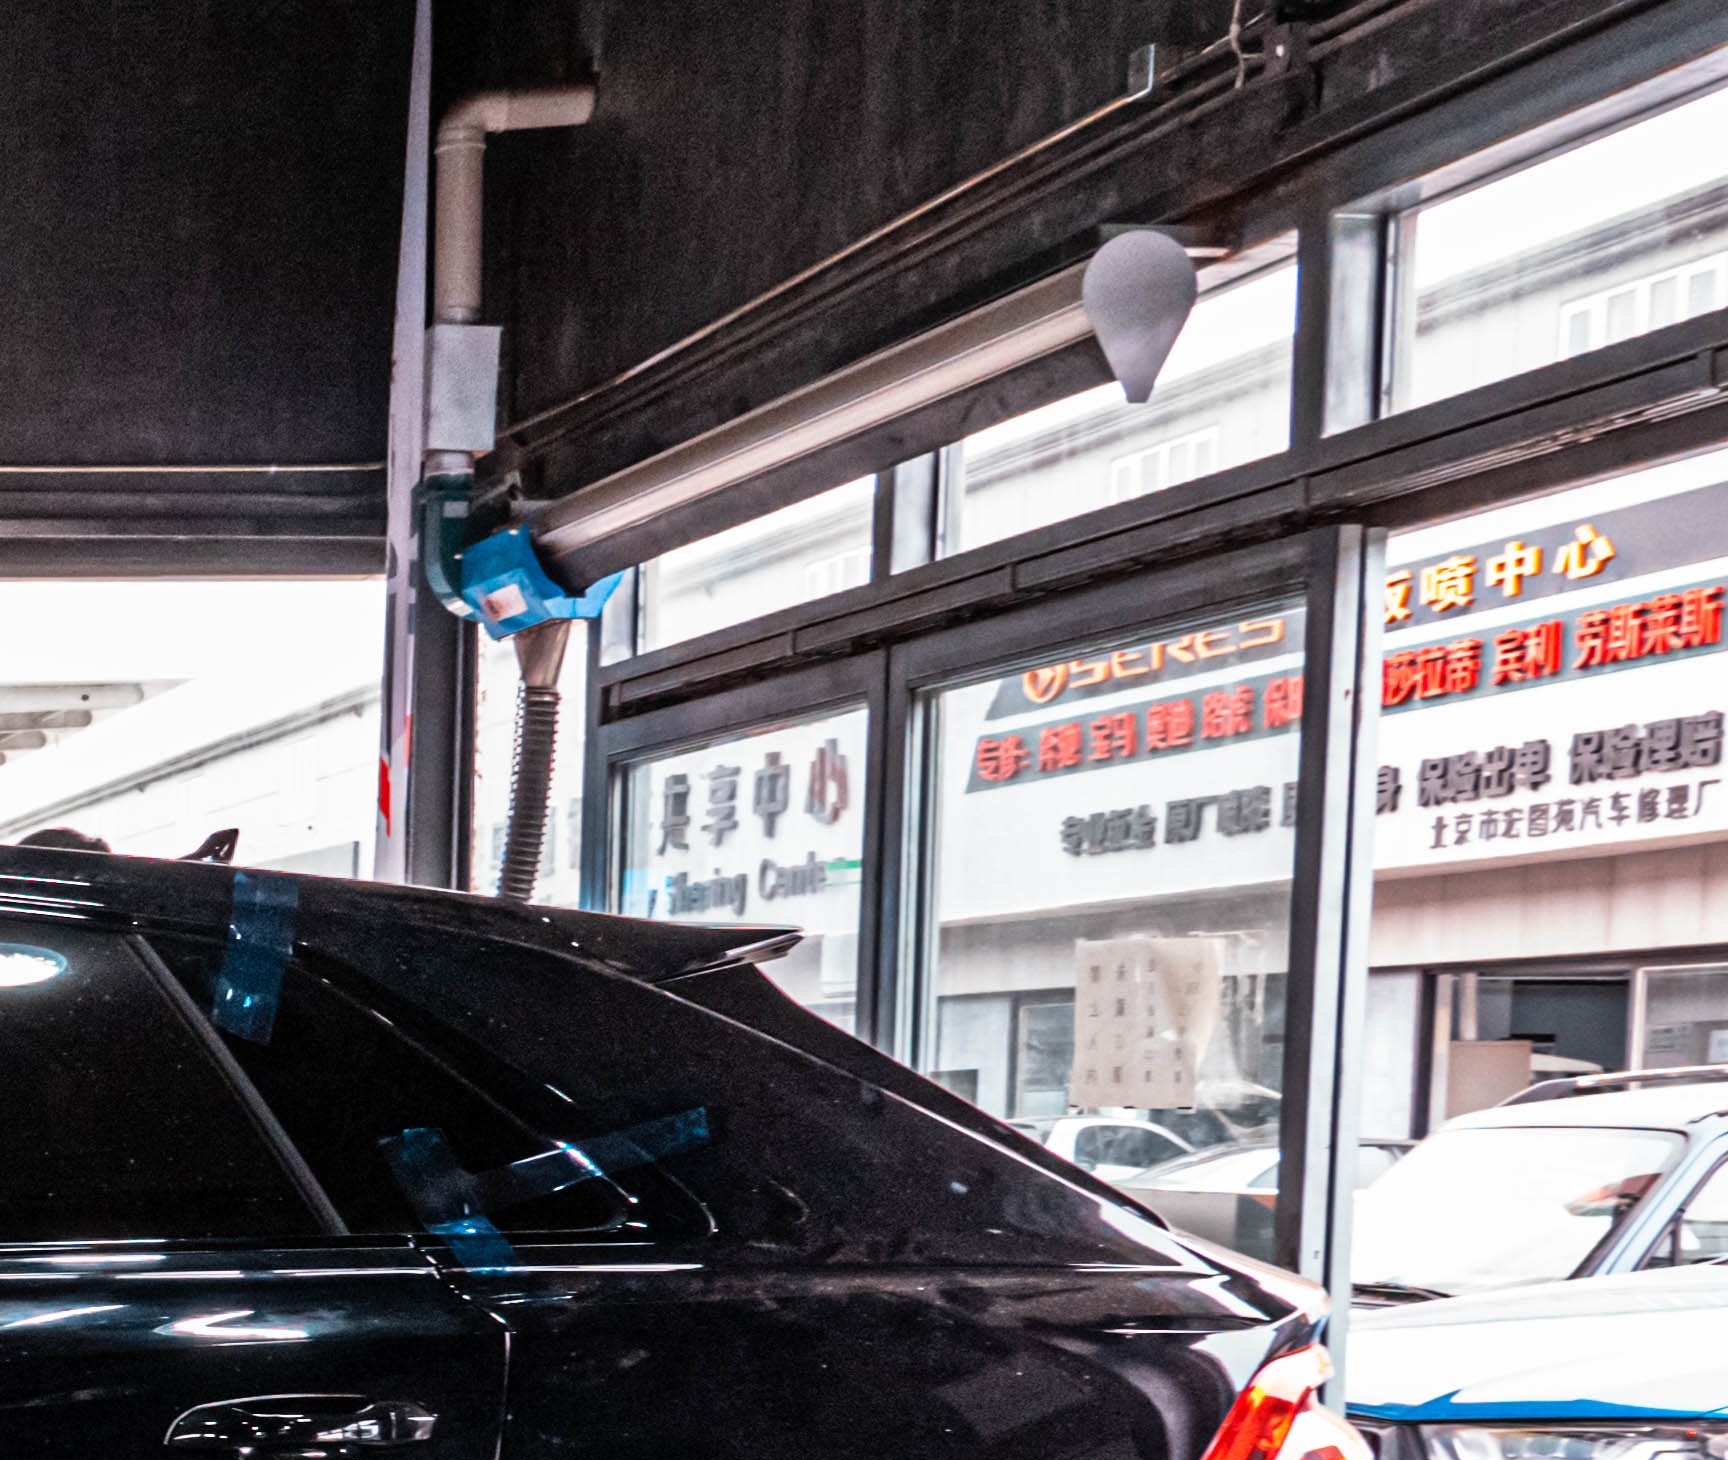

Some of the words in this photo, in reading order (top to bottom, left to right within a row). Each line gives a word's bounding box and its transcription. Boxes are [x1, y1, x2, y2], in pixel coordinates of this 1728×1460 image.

[1088, 712, 1137, 761] 宝马
[1491, 619, 1562, 686] 宾利
[1572, 586, 1726, 669] 劳斯莱斯
[1570, 710, 1725, 785] 保险理赔
